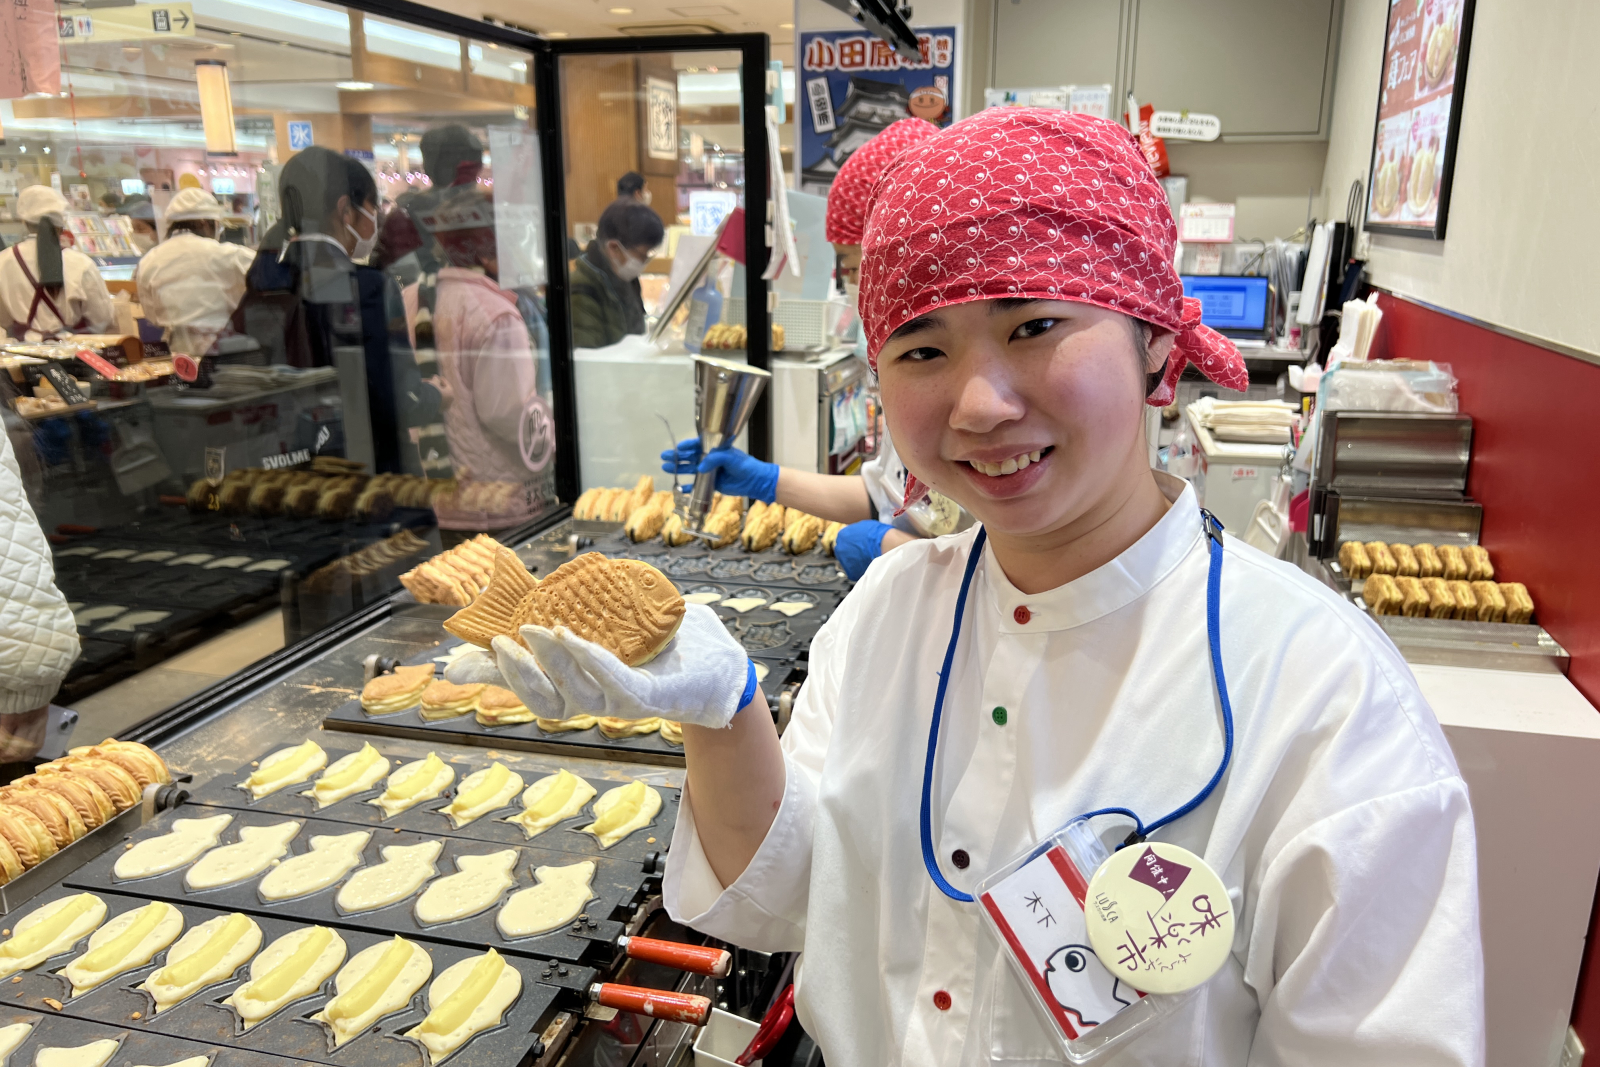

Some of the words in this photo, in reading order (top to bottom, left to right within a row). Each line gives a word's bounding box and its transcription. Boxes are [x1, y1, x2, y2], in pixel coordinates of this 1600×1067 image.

[1024, 891, 1057, 928] 木下
[1095, 891, 1119, 924] LUSCA
[1117, 894, 1228, 971] 味楽市
